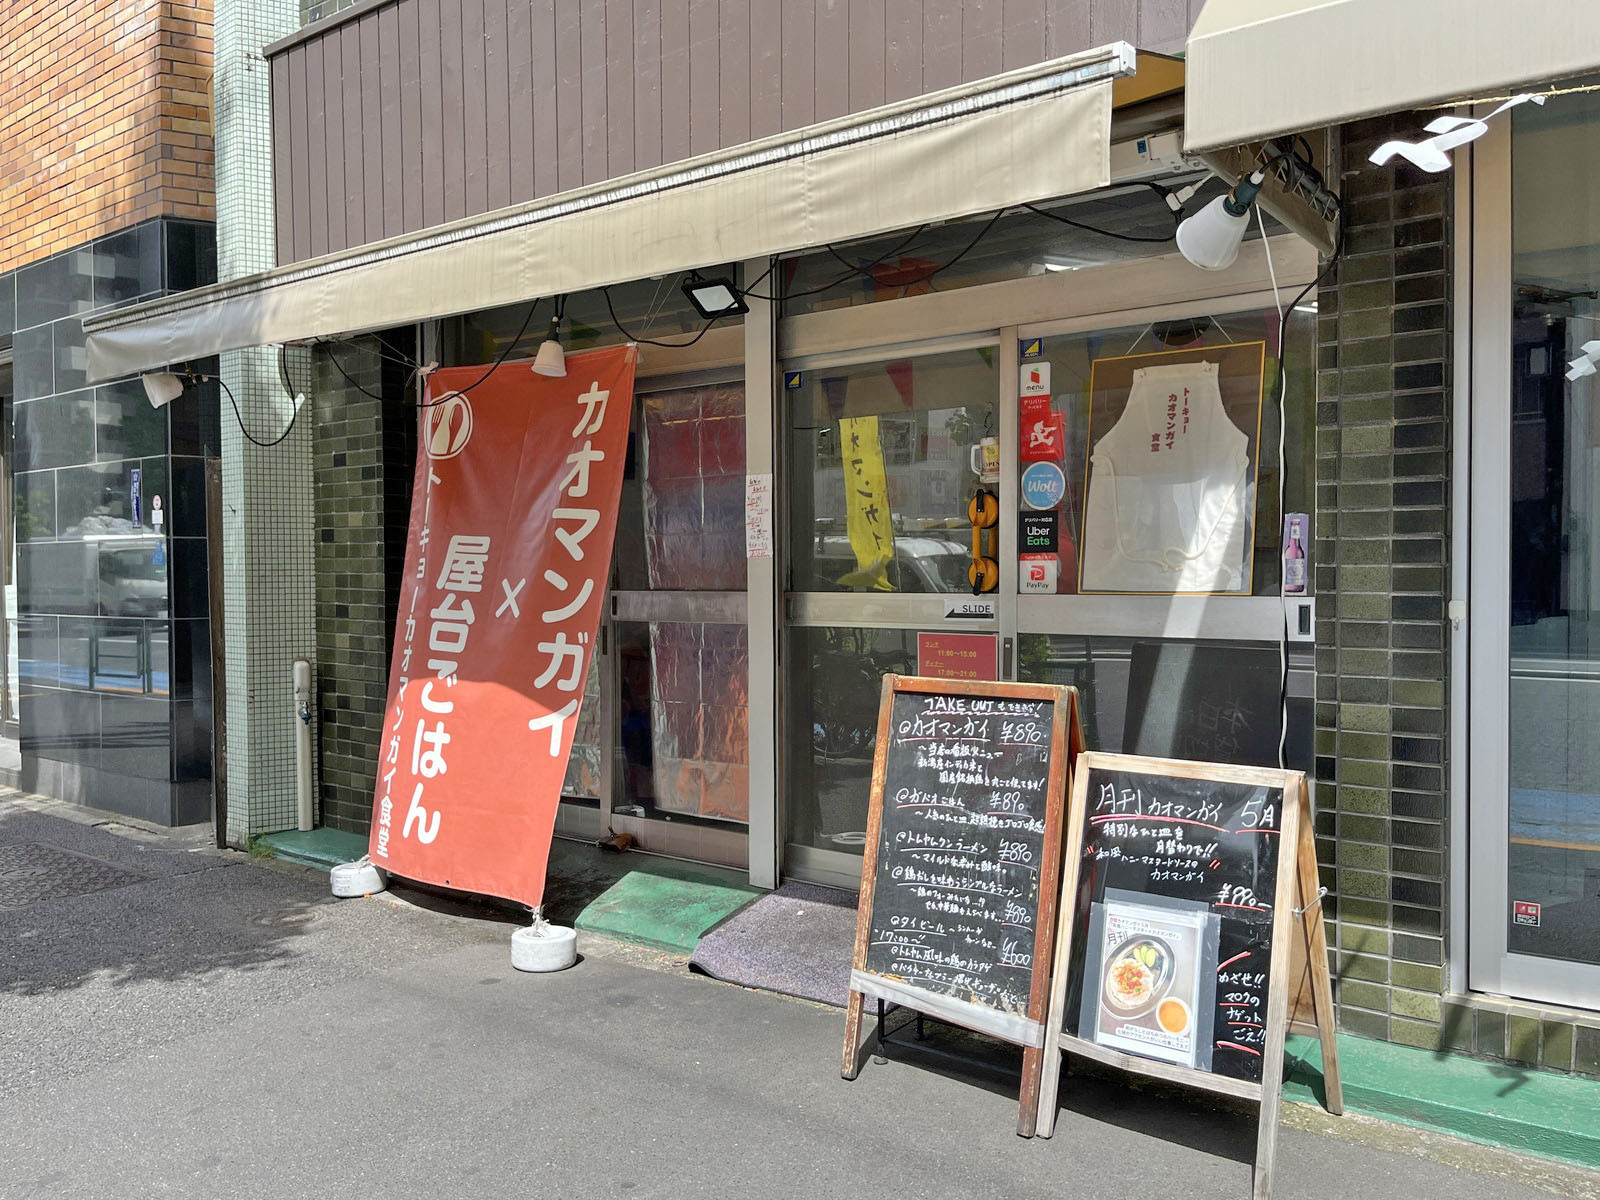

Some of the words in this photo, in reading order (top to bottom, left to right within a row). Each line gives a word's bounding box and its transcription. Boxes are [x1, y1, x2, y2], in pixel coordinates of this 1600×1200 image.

[1182, 387, 1190, 434] トーキョー
[1165, 394, 1177, 450] カオマンガイ
[1028, 480, 1057, 492] Wolt
[1027, 526, 1050, 535] Uber
[1027, 536, 1050, 546] Eats
[529, 381, 610, 758] カオマンガイ
[962, 604, 991, 613] SLIDE
[376, 467, 441, 858] トーキョーカオマンガイ食堂
[402, 534, 490, 845] 屋台ごはん
[924, 697, 966, 712] TAKE
[971, 700, 993, 712] OUT
[1000, 721, 1042, 743] ¥890
[990, 791, 1025, 813] ¥890
[1096, 782, 1142, 816] 月刊
[1148, 797, 1223, 822] カオマンガイ
[1240, 799, 1274, 828] 5月
[1103, 822, 1184, 840] 特別なひと皿を
[1151, 868, 1204, 884] カオマンガイ
[1226, 1007, 1262, 1022] ナゲット
